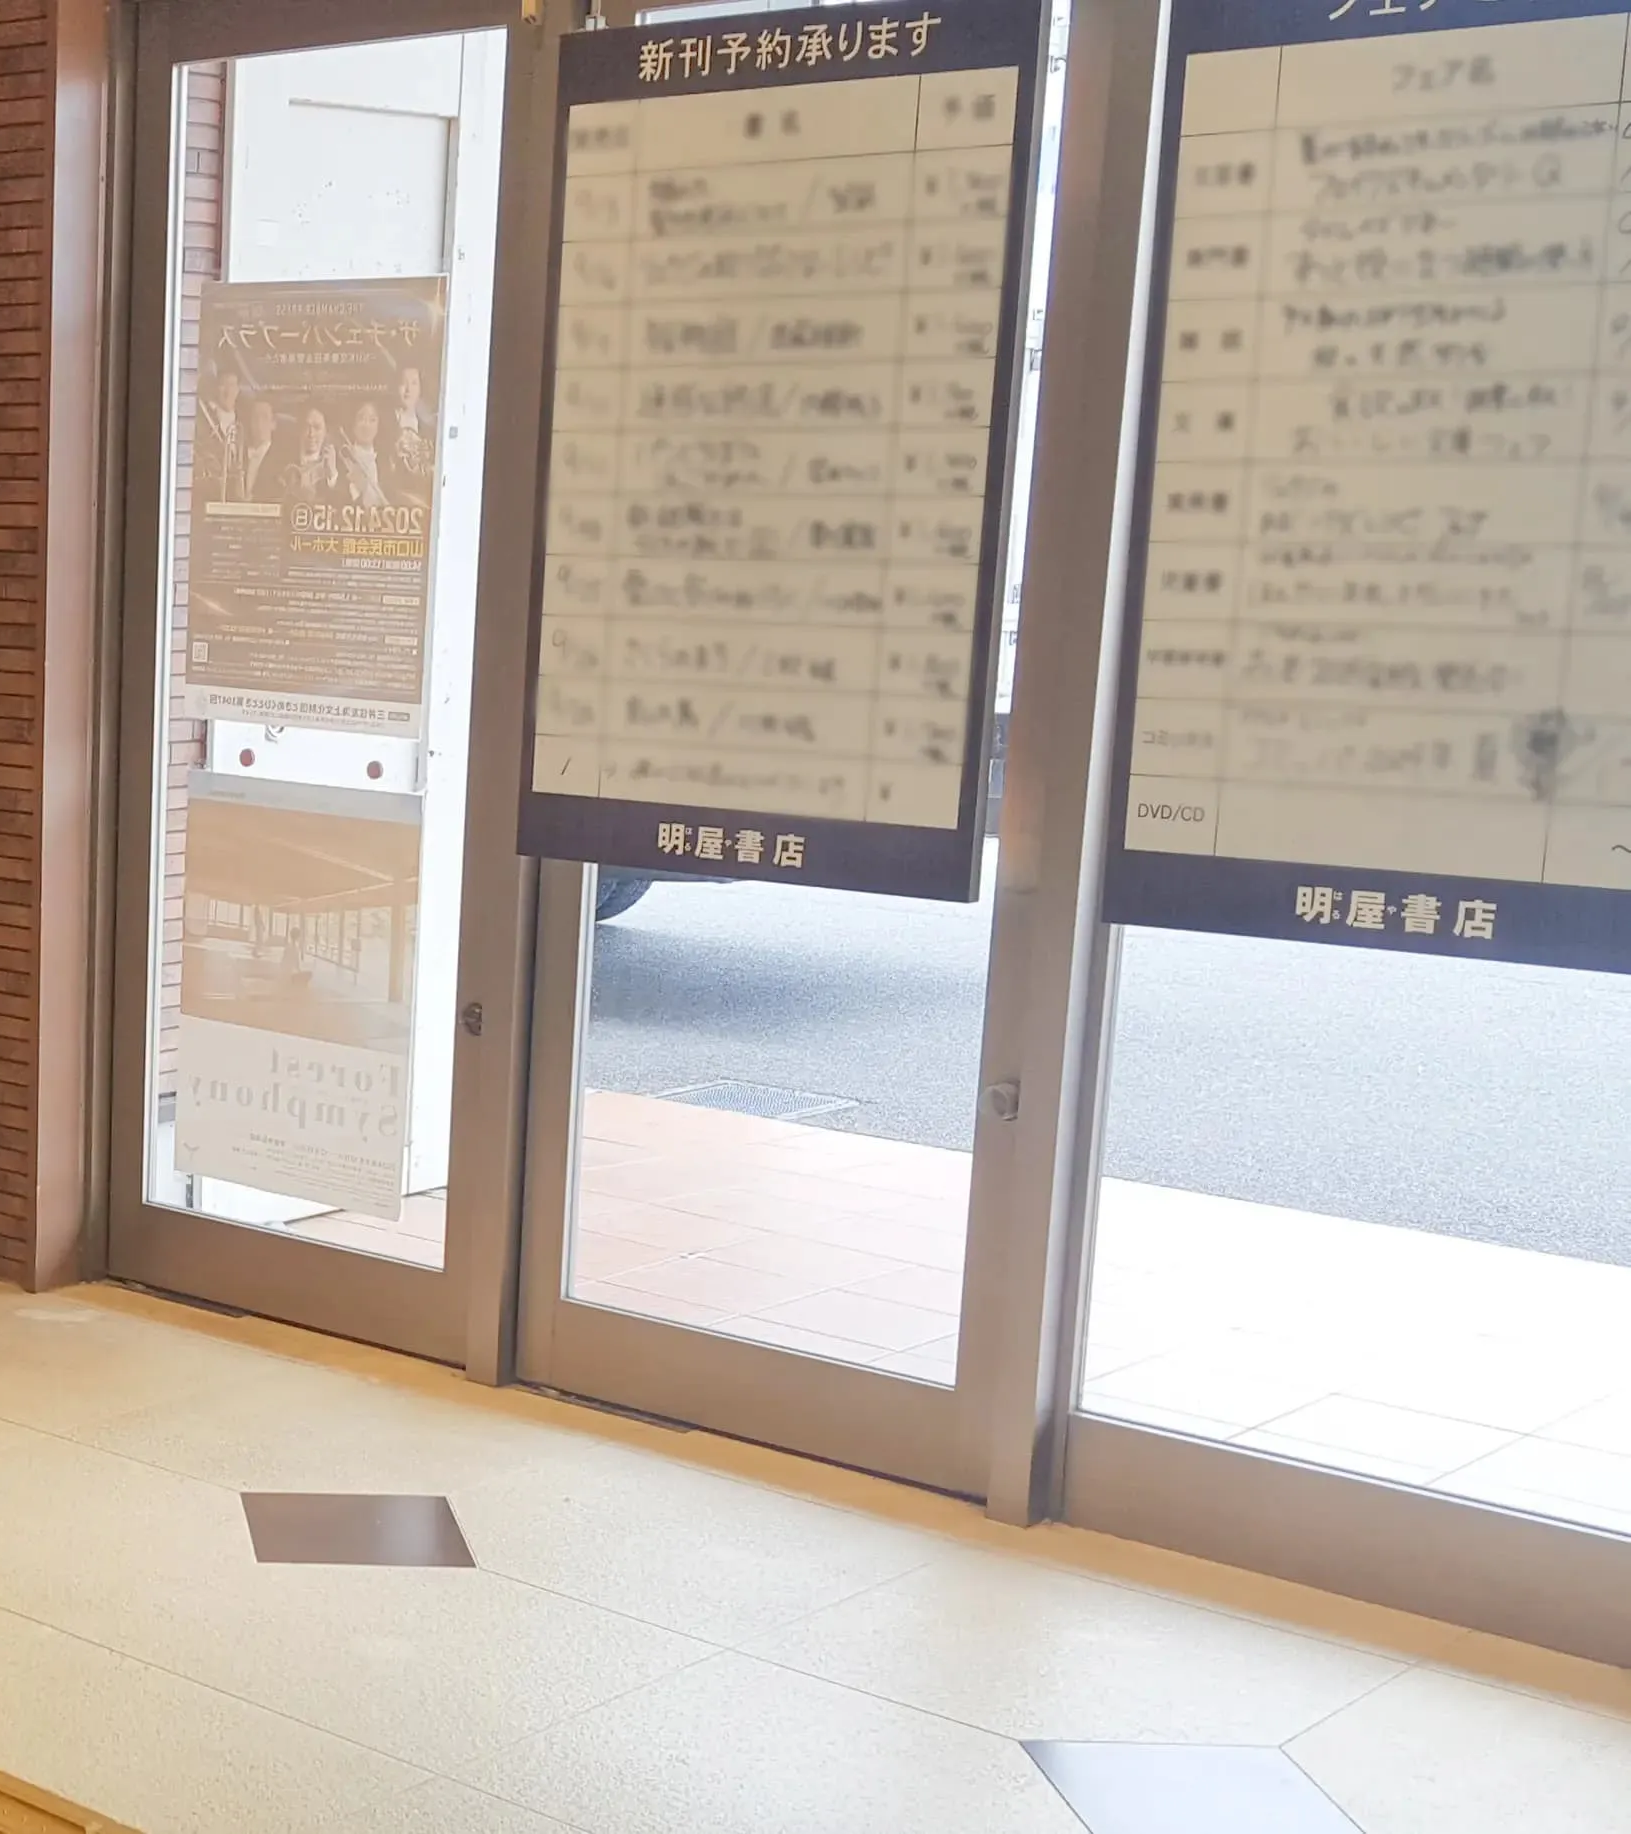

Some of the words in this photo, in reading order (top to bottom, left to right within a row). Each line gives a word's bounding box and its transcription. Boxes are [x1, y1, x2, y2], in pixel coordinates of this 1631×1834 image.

[639, 12, 941, 81] 新刊予約承ります
[1137, 803, 1206, 822] DVD/CD
[658, 822, 805, 868] 明屋書店
[1295, 886, 1497, 940] 明屋書店
